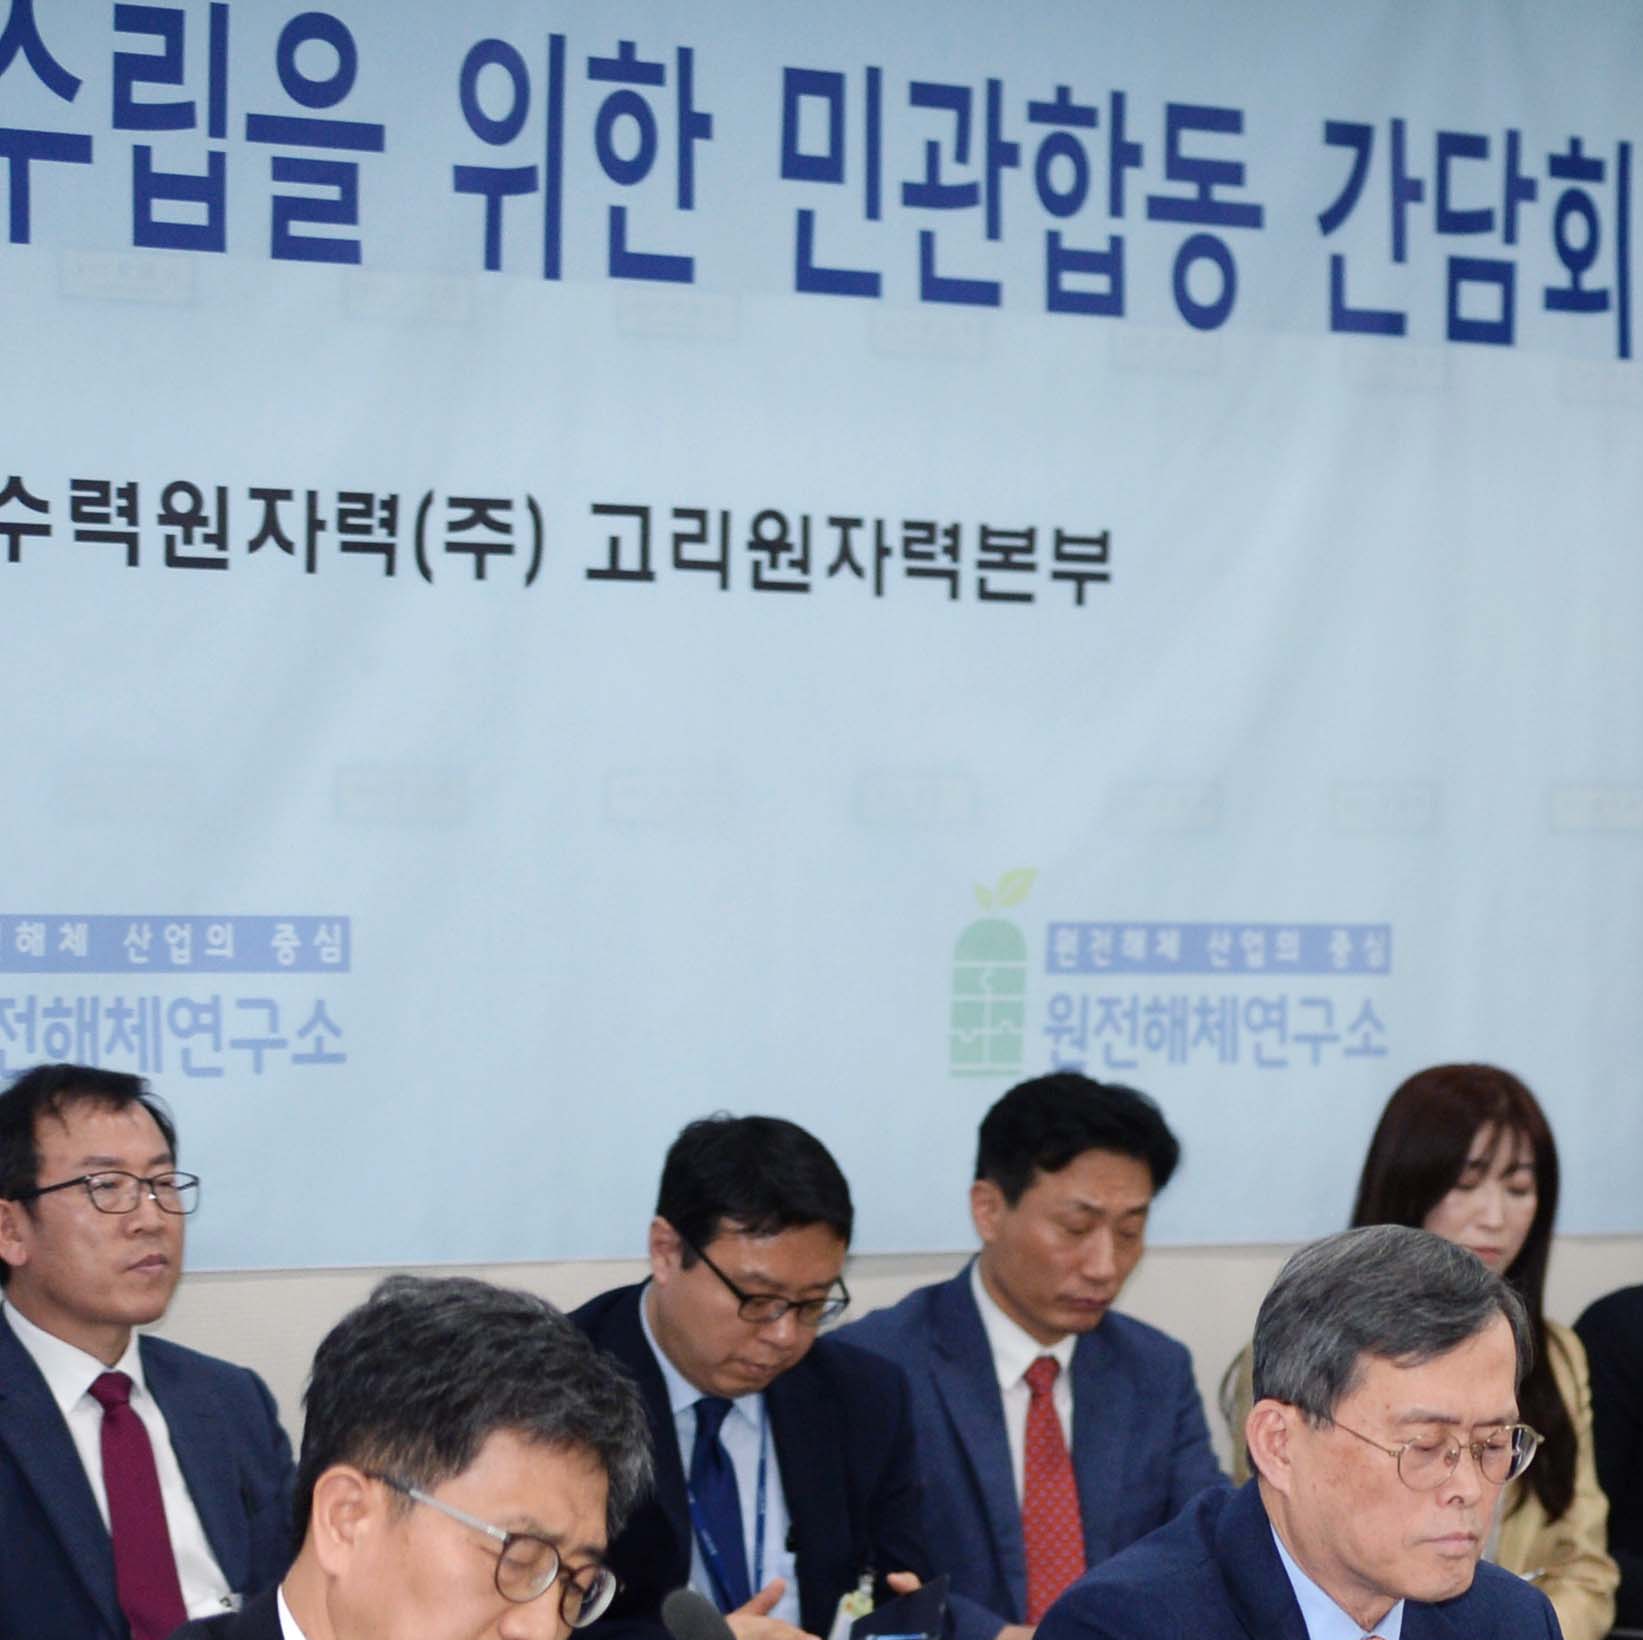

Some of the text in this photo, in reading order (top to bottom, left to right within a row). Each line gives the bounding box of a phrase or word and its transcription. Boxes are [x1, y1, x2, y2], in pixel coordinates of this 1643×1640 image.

[453, 33, 714, 281] 위한
[781, 65, 1265, 332] 민관합동
[1318, 117, 1632, 360] 간담회
[586, 502, 1112, 606] 고리원자력본부
[123, 921, 235, 965] 산업의
[271, 922, 342, 966] 중심
[1207, 927, 1301, 969] 산업의
[1328, 928, 1387, 970] 중심
[1043, 993, 1390, 1071] 원전해체연구소
